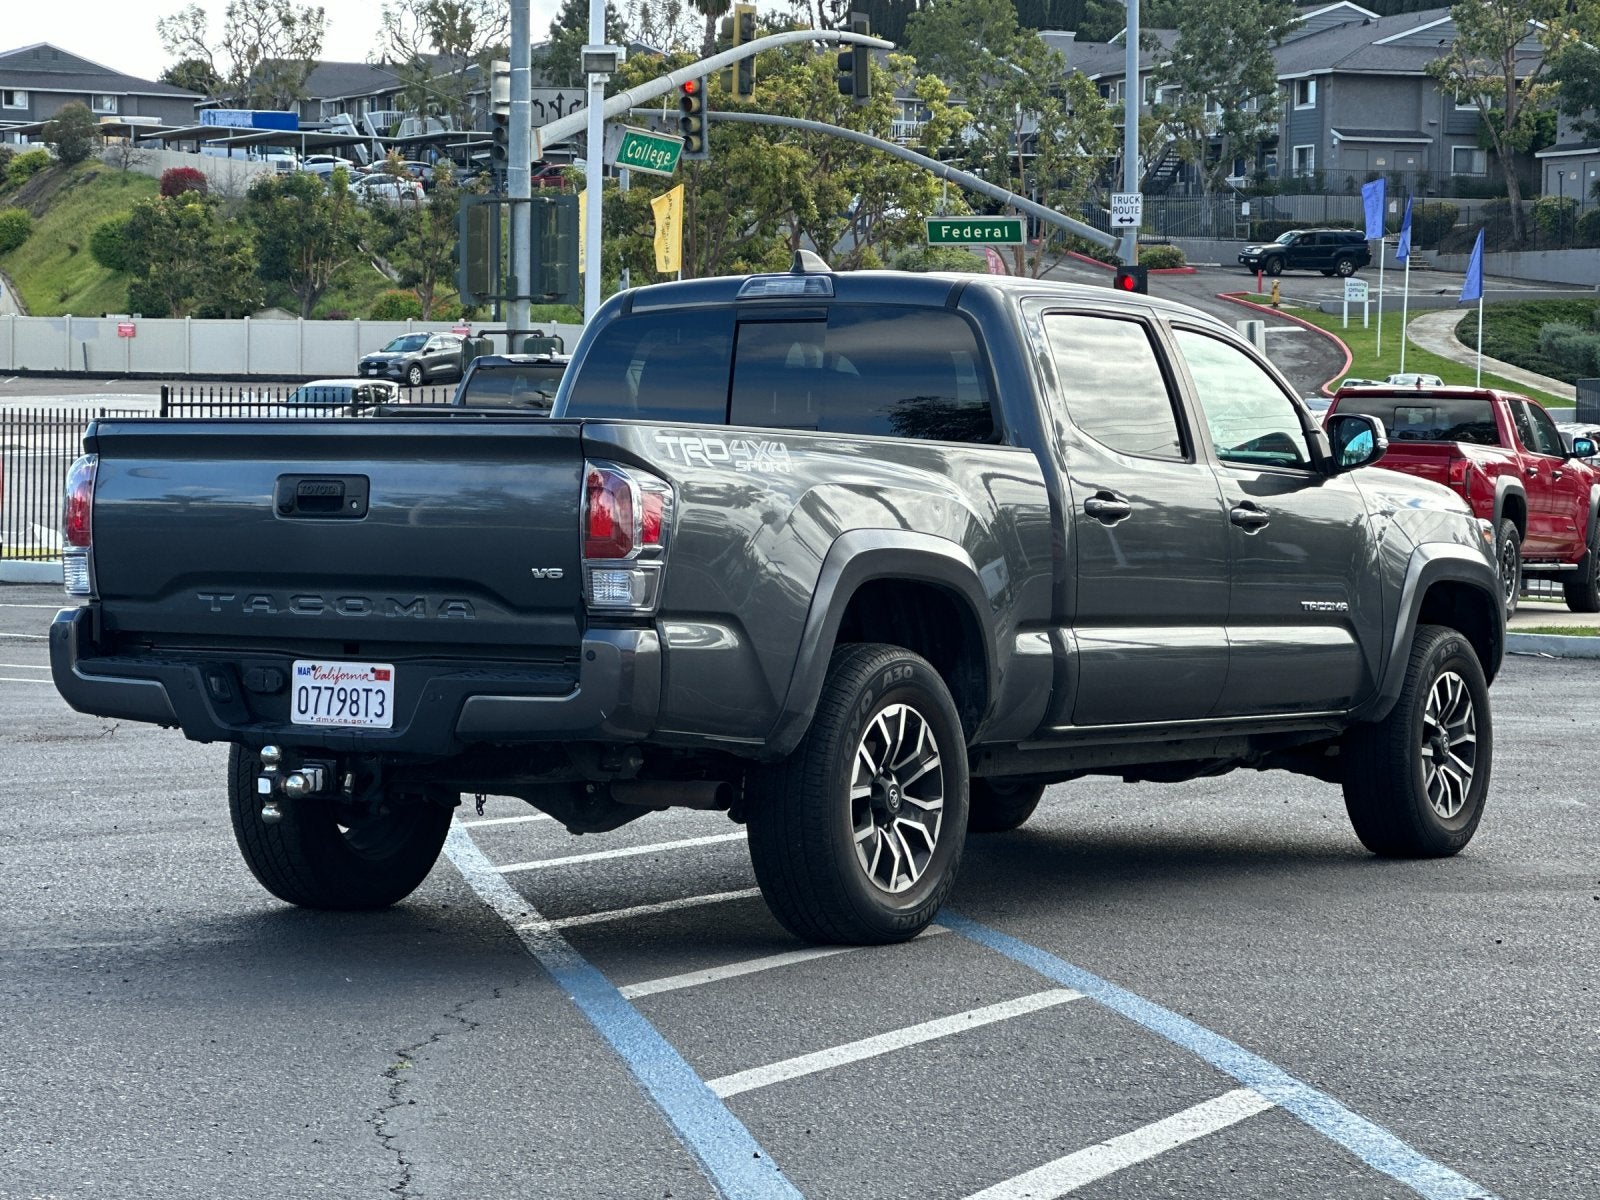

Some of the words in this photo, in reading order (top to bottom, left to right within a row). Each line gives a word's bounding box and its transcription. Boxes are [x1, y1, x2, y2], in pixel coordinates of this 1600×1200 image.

[627, 140, 671, 169] College
[1113, 196, 1140, 204] TRUCK
[1113, 206, 1140, 214] ROUTE
[941, 226, 1008, 238] Federal
[655, 436, 731, 467] TRD
[735, 460, 795, 473] SPORT
[300, 484, 340, 495] TOYOTA
[531, 567, 564, 579] V6
[196, 591, 476, 620] TACOMA
[1301, 601, 1349, 611] TACOMA
[297, 666, 312, 676] MAR
[313, 666, 375, 685] California
[882, 665, 914, 689] A30
[297, 686, 386, 718] 07798T3
[316, 716, 368, 725] dmv.ca.gov
